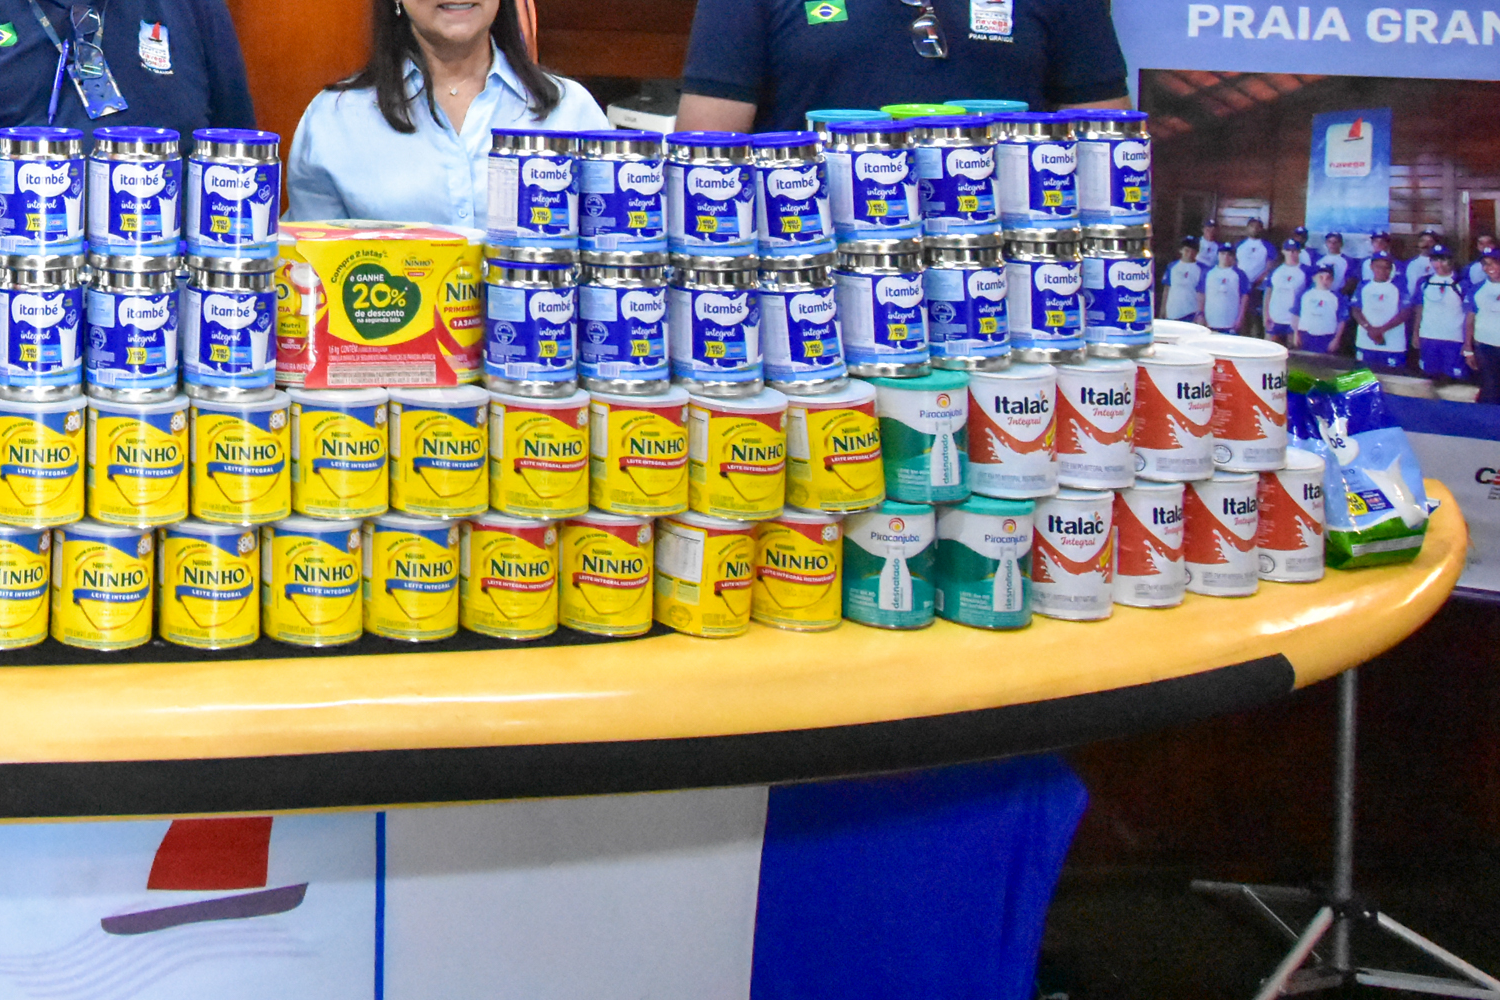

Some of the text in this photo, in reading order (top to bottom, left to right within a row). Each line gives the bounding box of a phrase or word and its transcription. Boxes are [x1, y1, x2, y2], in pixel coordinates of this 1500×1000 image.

[1187, 4, 1351, 42] PRAIA
[864, 159, 904, 175] itambé
[955, 155, 992, 171] itambé
[1041, 151, 1076, 166] itambé
[25, 170, 64, 186] itambé
[120, 172, 158, 187] itambé
[211, 174, 250, 189] itambé
[530, 168, 567, 181] itambé
[627, 170, 661, 184] itambé
[696, 175, 735, 190] itambé
[777, 175, 818, 190] itambé
[331, 254, 355, 283] Compre
[362, 250, 383, 258] latas
[1118, 266, 1151, 282] itambé
[357, 274, 384, 282] GANHE
[1044, 270, 1079, 285] itambé
[352, 283, 406, 309] 20%
[446, 282, 481, 302] NIN
[885, 283, 920, 298] itambé
[19, 301, 58, 316] itambé
[126, 305, 164, 320] itambé
[211, 303, 250, 318] itambé
[704, 300, 743, 315] itambé
[799, 300, 835, 316] itambé
[1262, 372, 1287, 390] Ital
[1080, 387, 1132, 406] Italac
[1177, 382, 1214, 400] Itala
[919, 408, 962, 419] Piracanjuba
[994, 395, 1049, 415] Italac
[1092, 407, 1125, 418] Integral
[1007, 416, 1042, 428] Integral
[321, 438, 380, 456] NINHO
[422, 438, 482, 456] NINHO
[524, 439, 583, 457] NINHO
[629, 437, 685, 455] NINHO
[832, 428, 880, 452] NINHO
[8, 445, 71, 464] NINHO
[116, 445, 178, 463] NINHO
[214, 443, 277, 461] NINHO
[731, 444, 784, 461] NINHO
[124, 467, 144, 475] LEITE
[1303, 483, 1321, 500] Ita
[1223, 496, 1258, 515] Itala
[1048, 512, 1104, 536] Italac
[1153, 507, 1183, 525] Itala
[870, 531, 920, 544] Piracanjuba
[984, 533, 1028, 544] Piracanjuba
[1060, 536, 1096, 548] Integral
[395, 559, 453, 578] NINHO
[490, 559, 550, 577] NINHO
[582, 554, 643, 574] NINHO
[765, 550, 829, 570] NINHO
[82, 568, 144, 587] NINHO
[183, 569, 245, 586] NINHO
[293, 564, 354, 582] NINHO
[725, 561, 750, 578] NIN
[302, 587, 321, 595] LEITE
[892, 558, 901, 609] desnatado
[1005, 559, 1013, 611] desnatado
